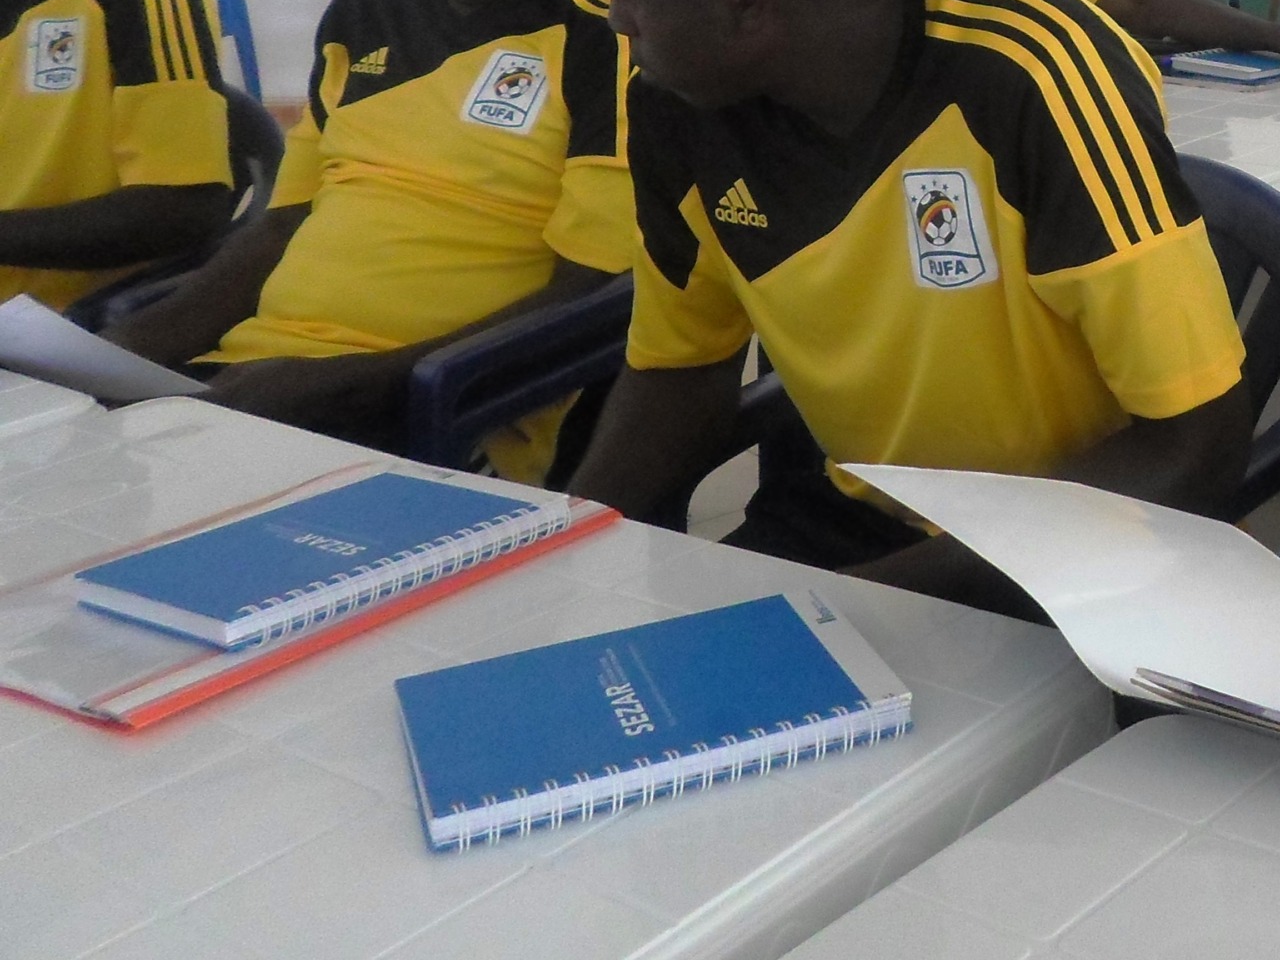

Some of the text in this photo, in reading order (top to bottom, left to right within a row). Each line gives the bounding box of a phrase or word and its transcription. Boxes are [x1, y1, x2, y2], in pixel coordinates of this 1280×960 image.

[350, 62, 386, 75] adidas
[479, 104, 515, 121] FUFA
[715, 206, 768, 228] adidas
[928, 259, 969, 276] FUFA
[293, 533, 367, 556] SEZAR
[605, 682, 655, 736] SEZAR
